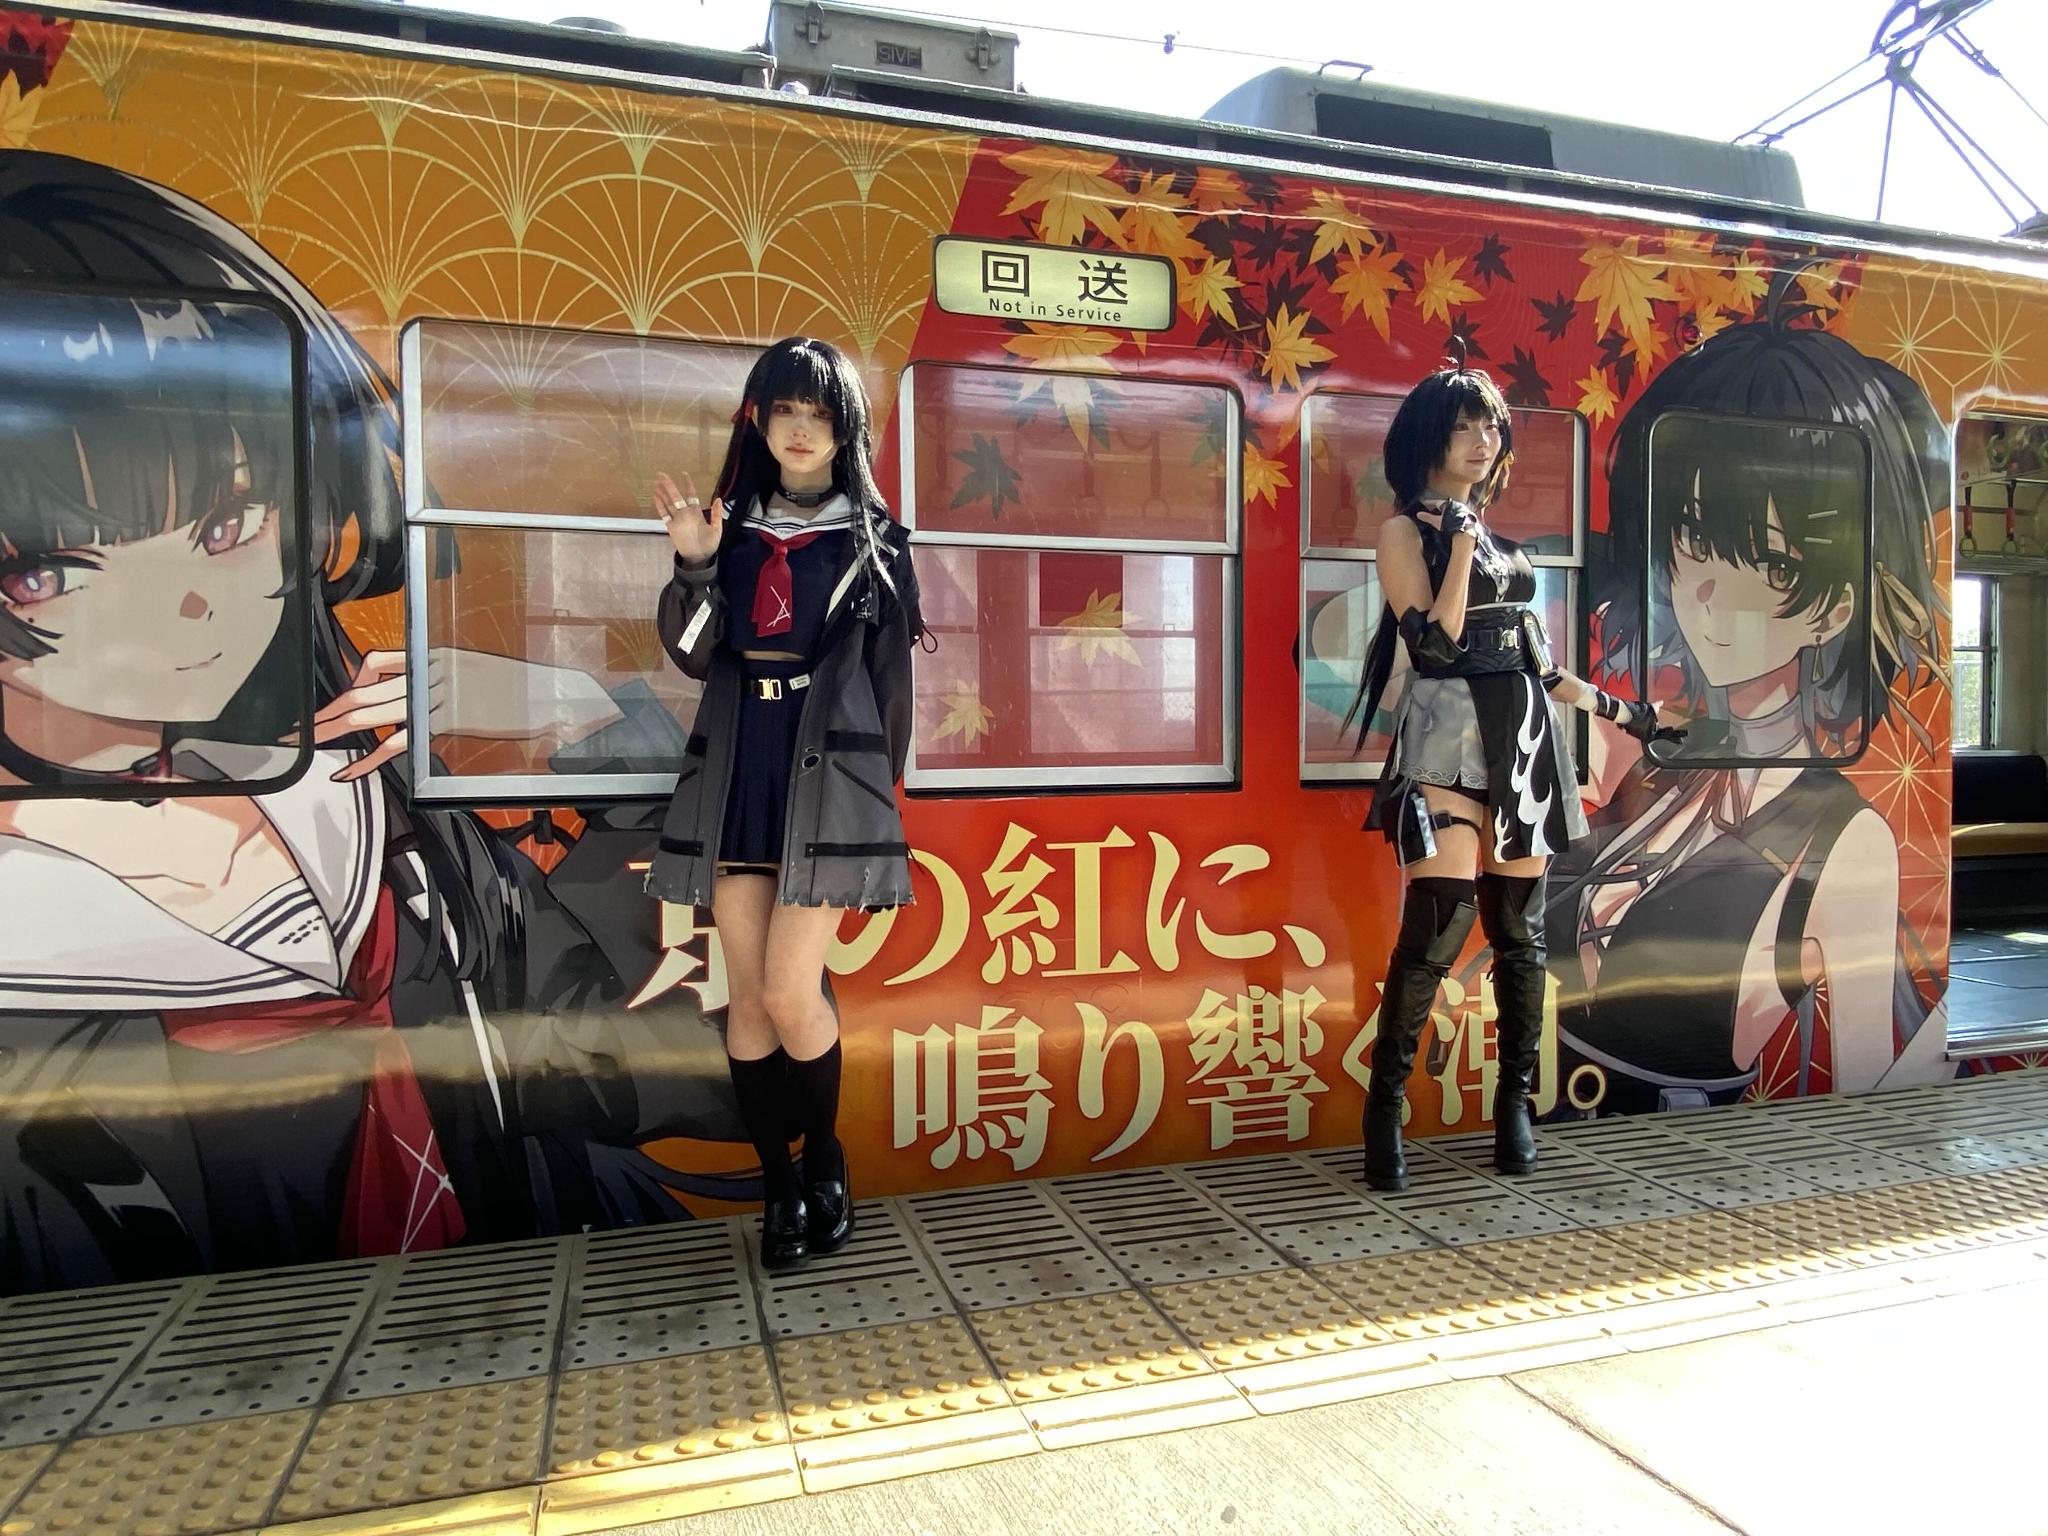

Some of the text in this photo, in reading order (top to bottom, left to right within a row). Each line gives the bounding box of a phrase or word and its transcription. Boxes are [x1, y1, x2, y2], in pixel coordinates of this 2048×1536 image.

[982, 250, 1128, 304] 回送
[989, 298, 1122, 322] Not in Service
